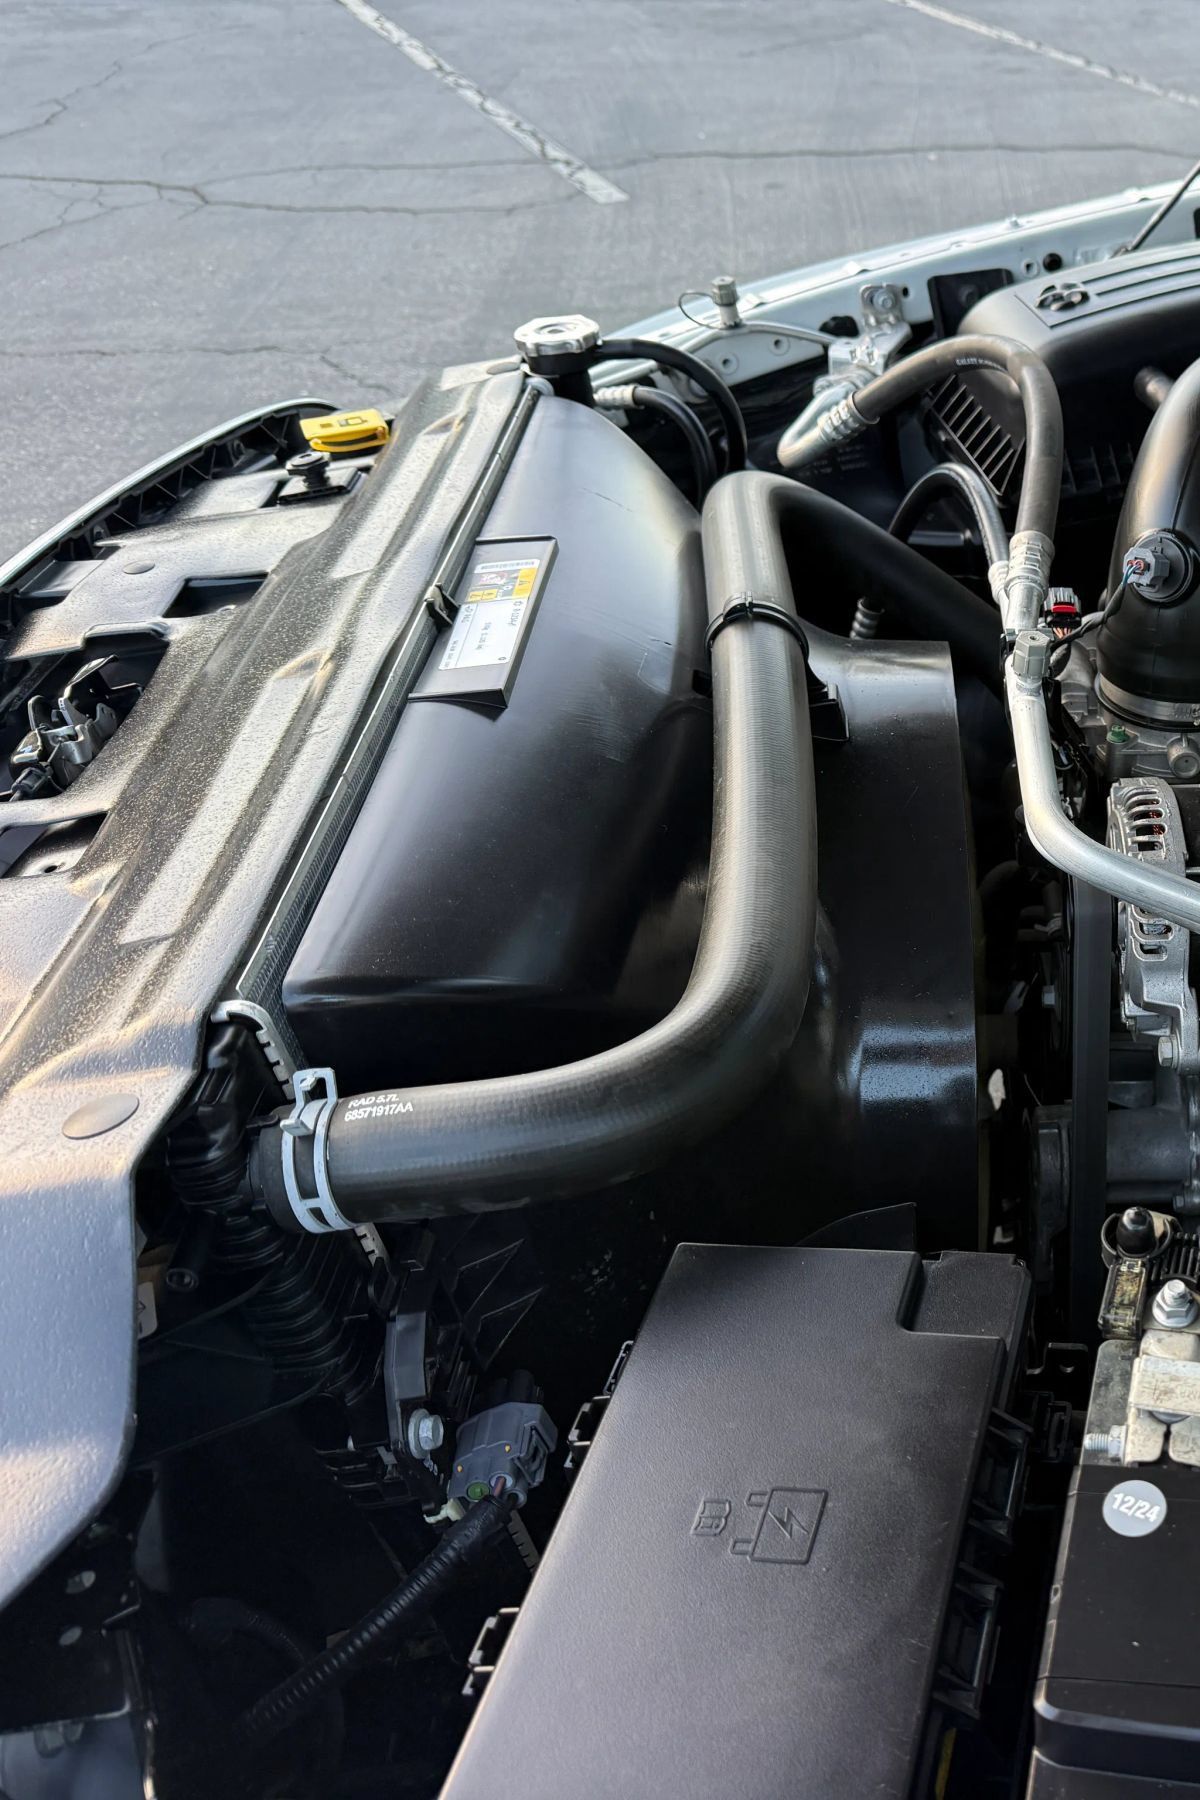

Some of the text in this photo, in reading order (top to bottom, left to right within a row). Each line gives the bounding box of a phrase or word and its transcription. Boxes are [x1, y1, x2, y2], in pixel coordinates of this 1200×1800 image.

[347, 1093, 399, 1108] RAD 5.7L
[343, 1102, 413, 1121] 68571917AA
[1112, 1492, 1160, 1522] 12/24
